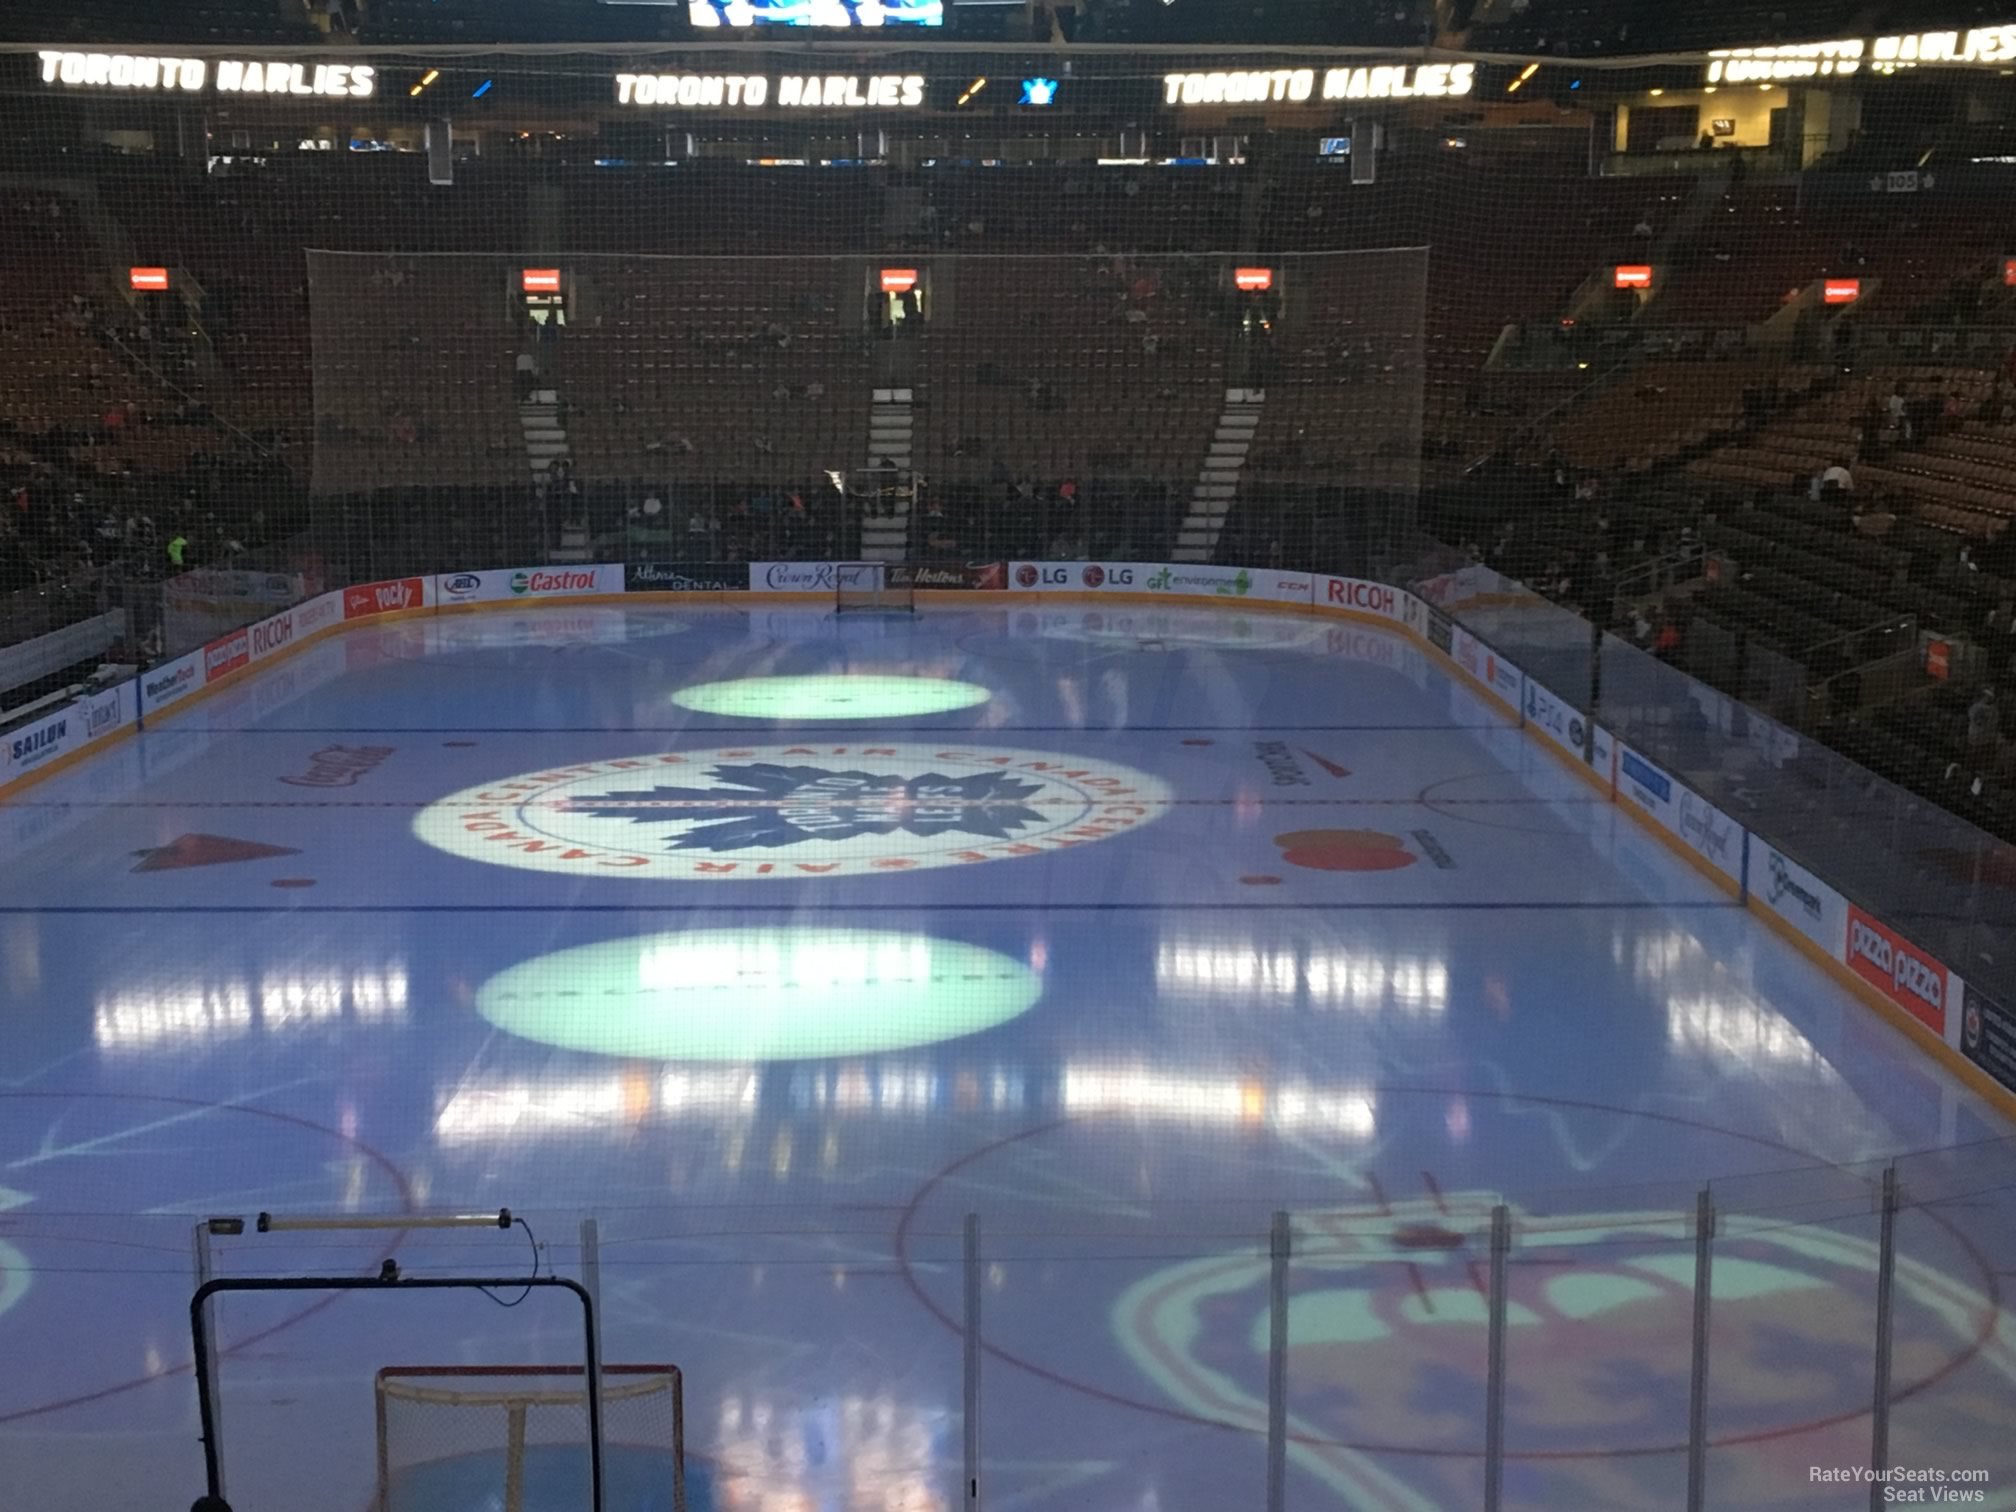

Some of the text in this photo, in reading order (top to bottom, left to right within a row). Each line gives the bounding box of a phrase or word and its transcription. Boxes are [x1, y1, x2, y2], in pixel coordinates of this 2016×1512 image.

[38, 50, 205, 90] TORONTO
[1707, 38, 1864, 82] TORONTO
[616, 73, 768, 105] TORONTO
[1164, 69, 1314, 103] TORONTO
[530, 569, 597, 592] Castrol
[766, 563, 812, 589] Crown
[1042, 568, 1067, 584] LG
[1108, 569, 1133, 585] LG
[1327, 578, 1395, 614] RICOH
[253, 613, 293, 656] RICOH
[13, 718, 67, 760] SAILUN
[782, 747, 897, 757] AIR
[913, 785, 963, 822] LEFS
